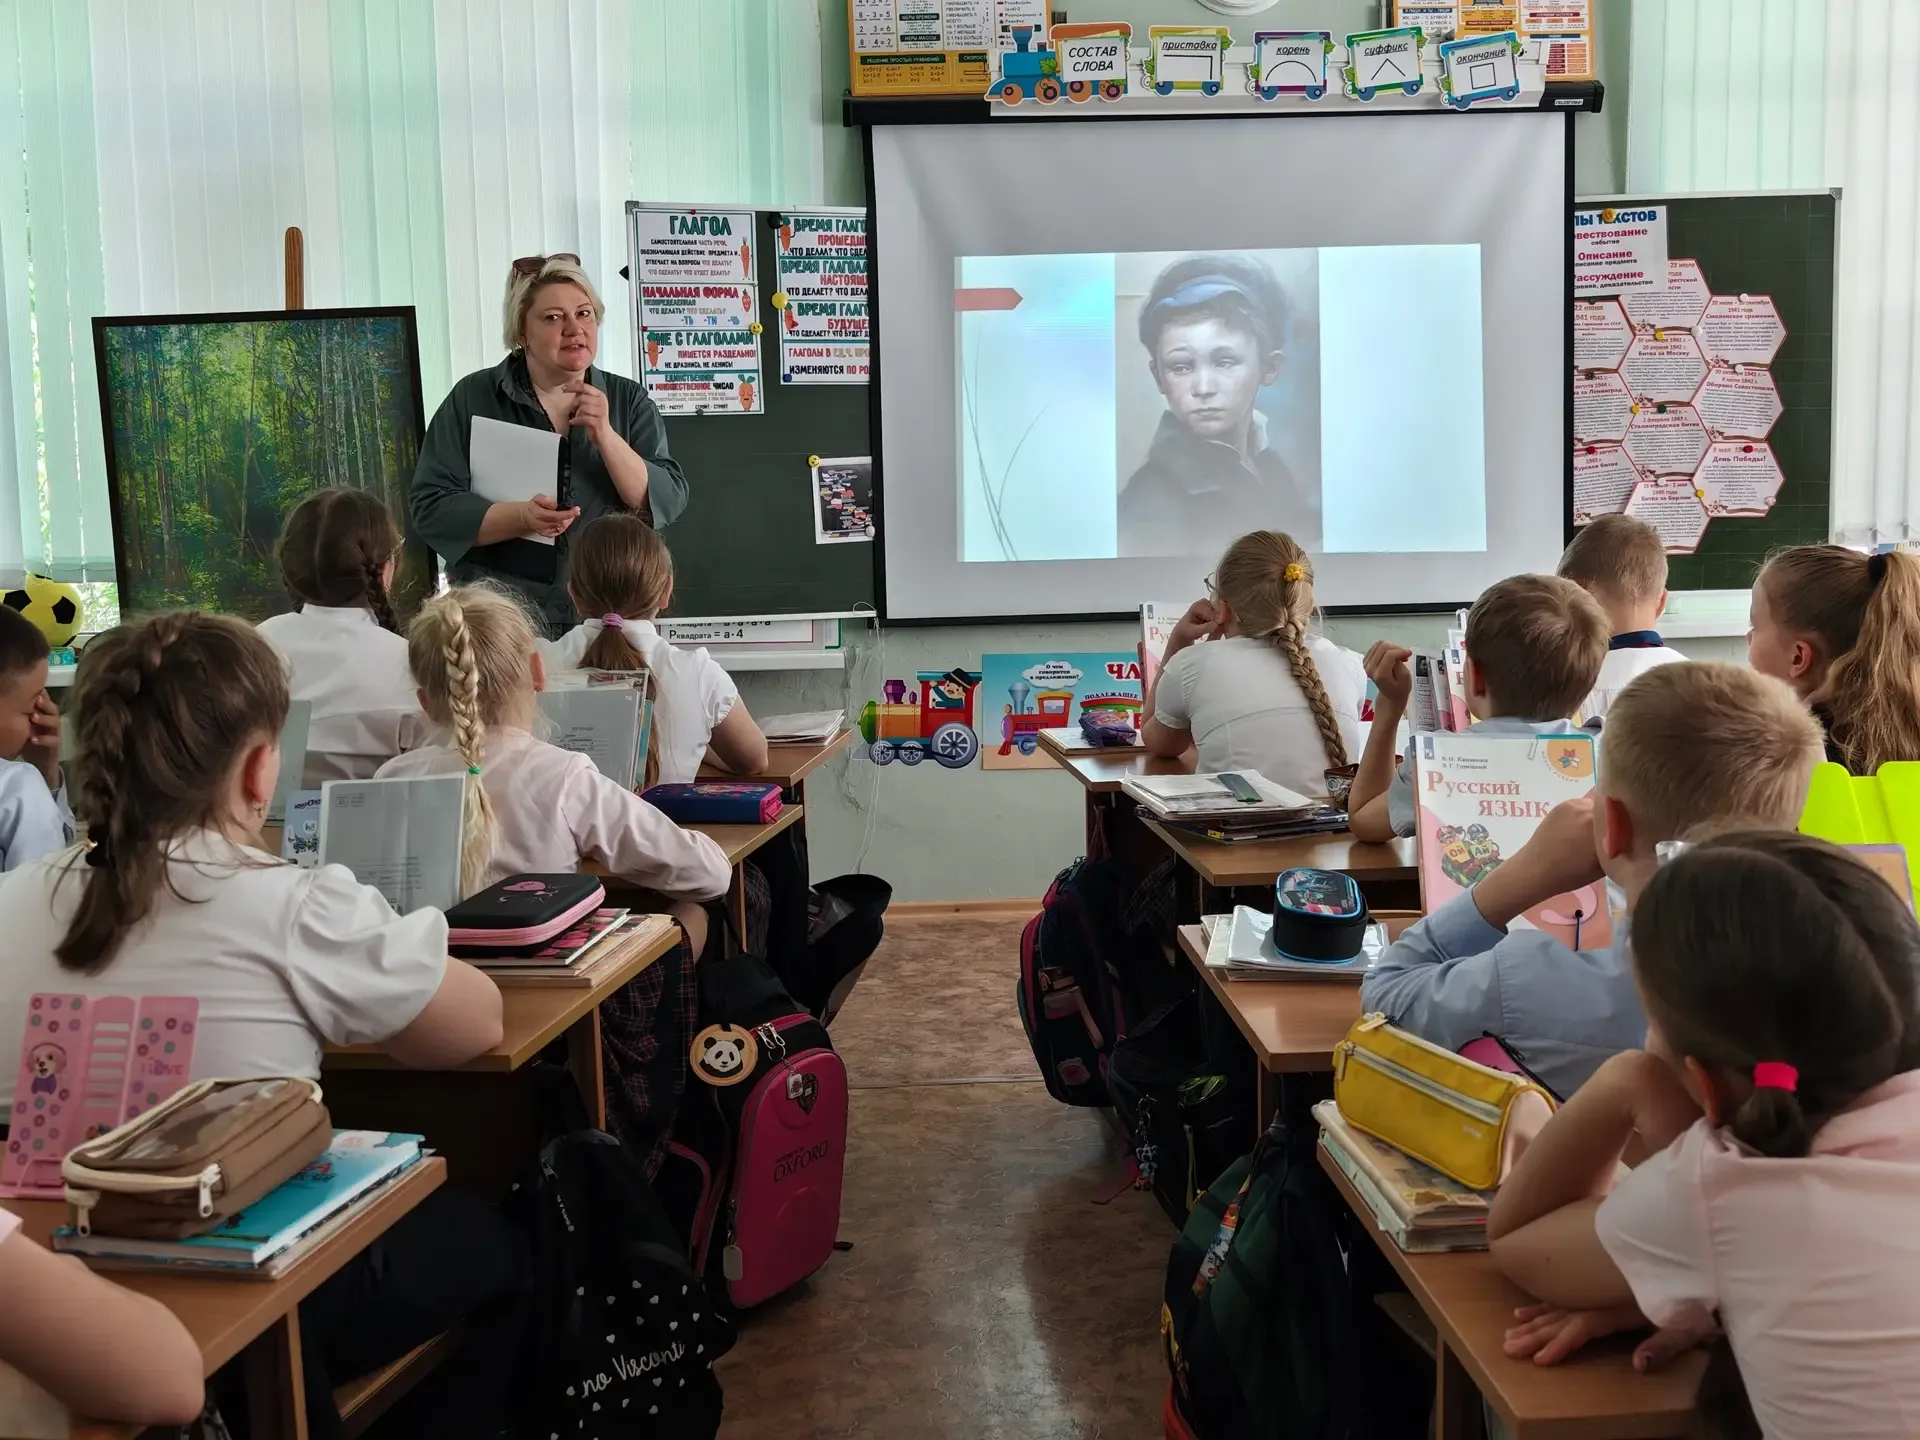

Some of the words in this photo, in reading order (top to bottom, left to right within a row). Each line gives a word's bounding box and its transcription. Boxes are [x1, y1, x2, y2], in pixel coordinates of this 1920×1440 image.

[1162, 40, 1218, 51] приставка
[1276, 45, 1311, 56] корень
[1364, 41, 1408, 56] суффикс
[1068, 46, 1117, 58] СОСТАВ
[1456, 47, 1506, 65] окончание
[1073, 61, 1113, 72] СЛОВА
[1597, 210, 1657, 224] ТКСТОВ
[669, 215, 732, 236] ГЛАГОЛ
[794, 219, 832, 232] ВРЕМЯ
[817, 234, 867, 246] ПРОШЕДШ
[1575, 228, 1648, 240] вествование
[790, 248, 803, 256] ЧТО
[805, 248, 832, 256] ДЕЛАЛ?
[835, 248, 848, 256] ЧТО
[1578, 251, 1633, 261] Описание
[781, 260, 819, 274] ВРЕМЯ
[820, 274, 868, 285] НАСТОЯЩ
[1600, 280, 1653, 289] доказательство
[642, 286, 700, 298] НАЧАЛЬНАЯ
[703, 286, 739, 299] ФОРМА
[802, 287, 833, 296] ДЕЛАЕТ?
[835, 288, 848, 296] ЧТО
[797, 303, 836, 316] ВРЕМЯ
[681, 316, 694, 325] -ТЬ
[828, 319, 869, 330] БУДУЩЕ
[656, 332, 672, 346] НЕ
[675, 332, 684, 346] С
[686, 332, 754, 346] ГЛАГОЛАМИ
[678, 350, 711, 359] ПИШЕТСЯ
[713, 350, 756, 358] РАЗДЕЛЬНО!
[789, 348, 823, 357] ГЛАГОЛЫ
[826, 348, 831, 357] В
[789, 365, 844, 375] ИЗМЕНЯЮТСЯ
[847, 365, 856, 374] ПО
[859, 365, 869, 375] РО
[1084, 691, 1139, 701] ПОДЛЕЖАЩЕЕ
[1426, 771, 1521, 797] Русский
[774, 1140, 828, 1182] OXFORD
[582, 1372, 612, 1399] no
[612, 1341, 685, 1380] Visconti
